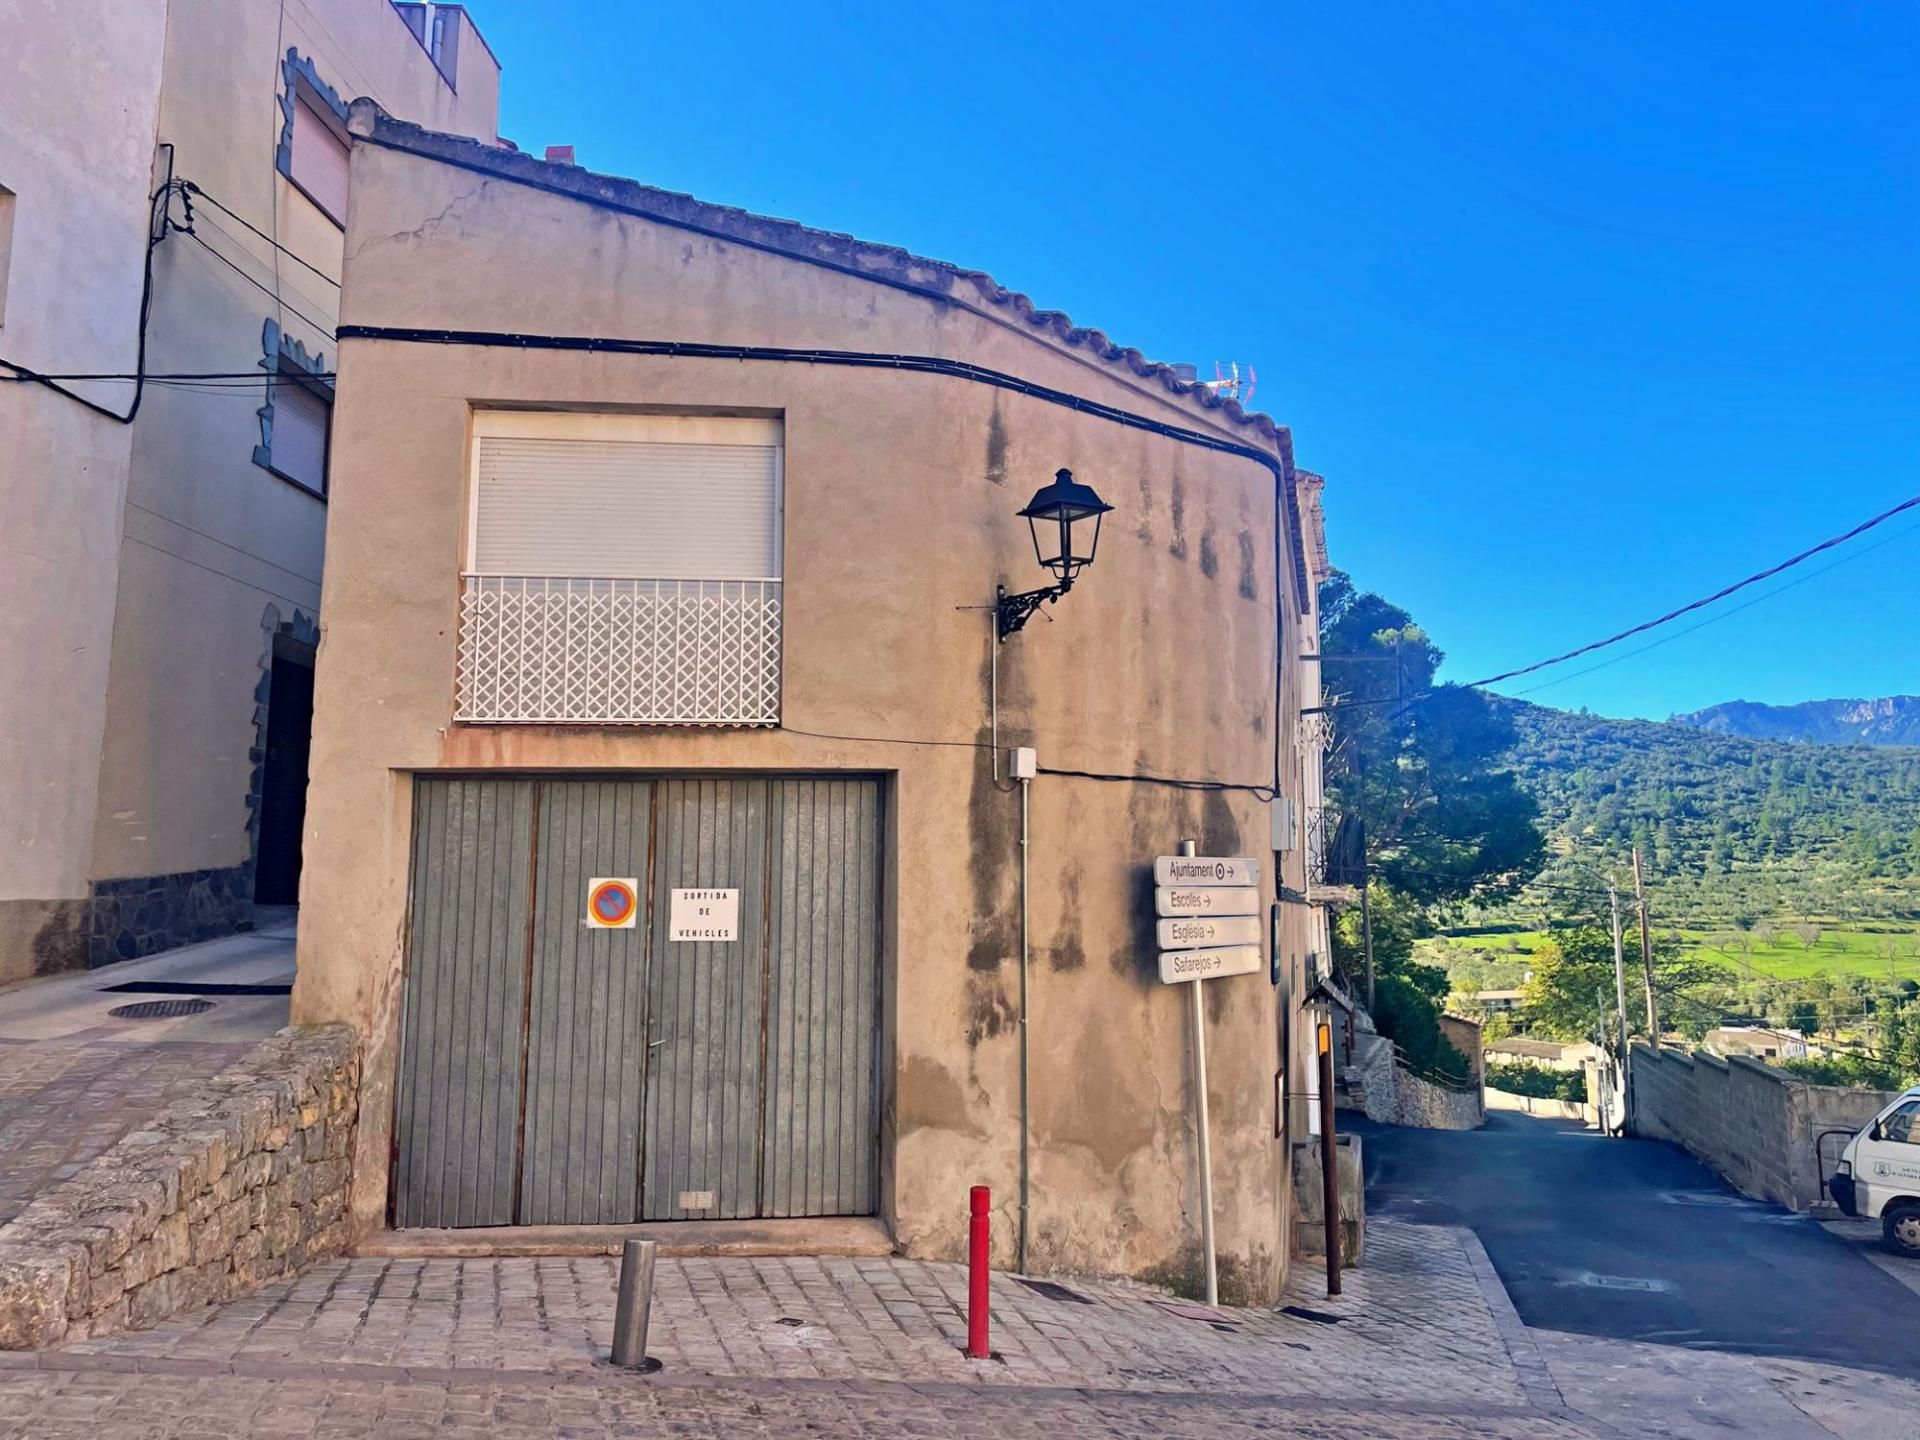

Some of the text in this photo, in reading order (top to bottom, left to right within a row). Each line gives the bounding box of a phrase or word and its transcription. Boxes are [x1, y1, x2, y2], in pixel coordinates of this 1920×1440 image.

[1170, 861, 1214, 880] Ajuntament
[684, 892, 727, 900] SORTIDA
[1171, 891, 1202, 908] Escoles
[679, 929, 729, 937] VEHICLES
